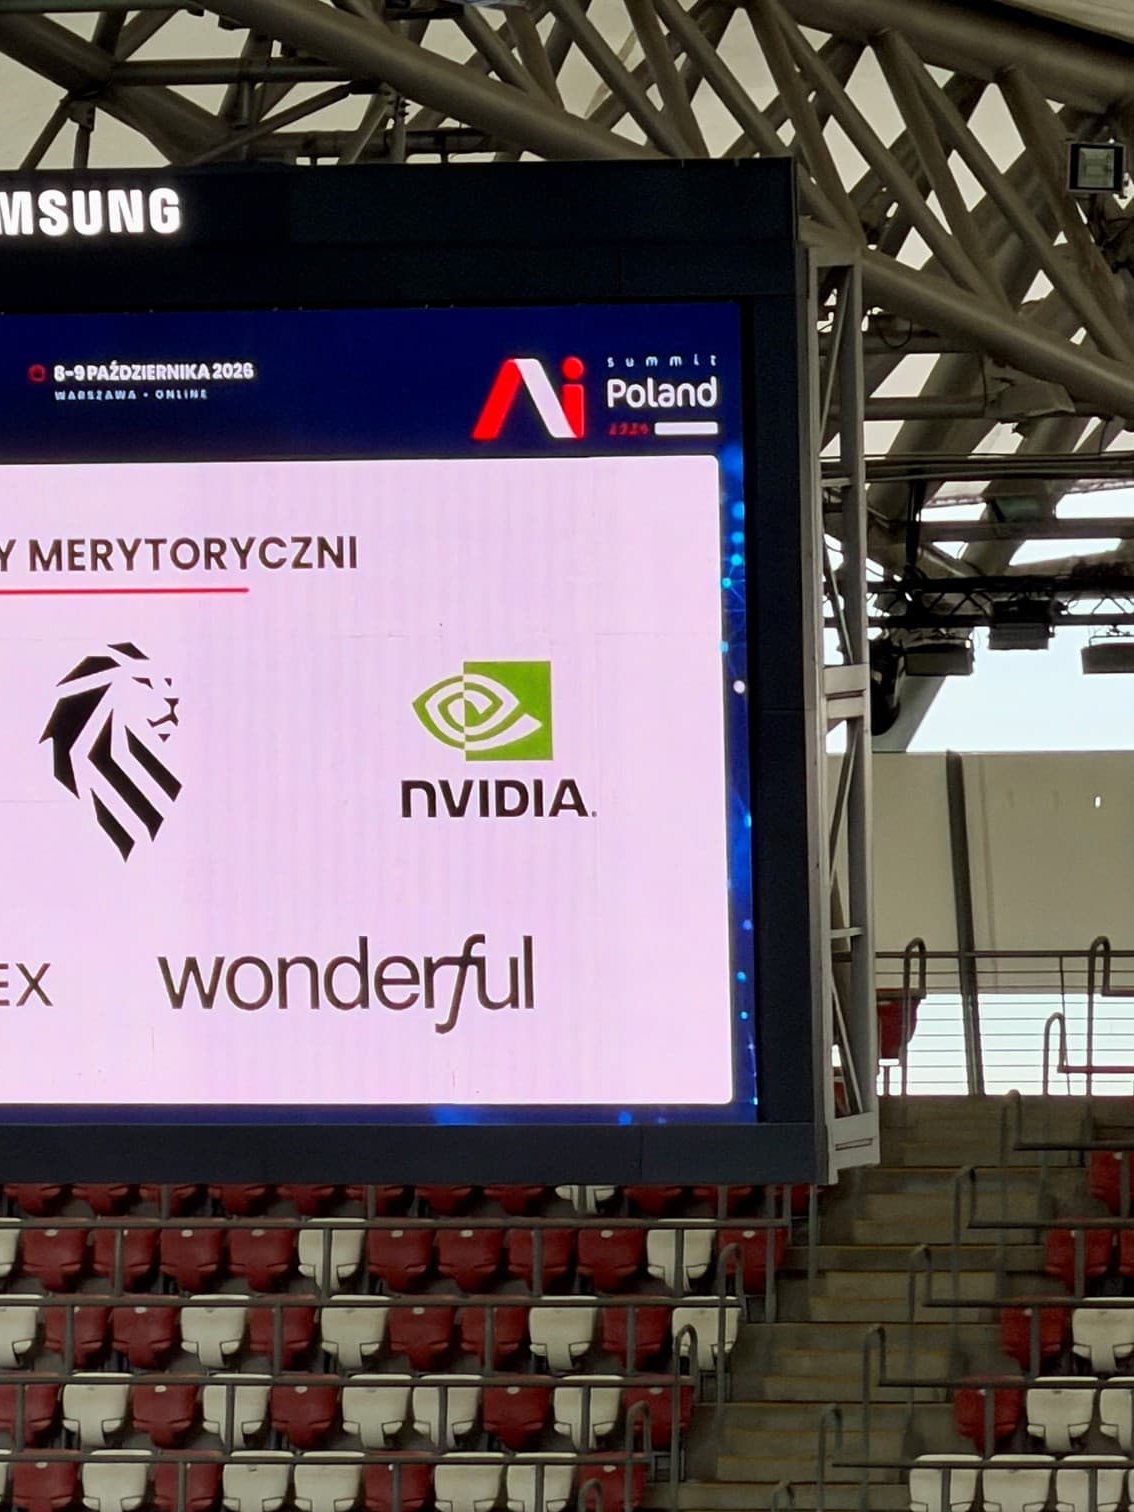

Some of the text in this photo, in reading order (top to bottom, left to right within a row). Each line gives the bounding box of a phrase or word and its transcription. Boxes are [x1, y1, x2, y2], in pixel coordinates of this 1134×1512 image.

[87, 360, 211, 382] PAŹDZIERNIKA
[607, 354, 717, 368] summit
[54, 389, 137, 401] WARSZAWA
[155, 388, 208, 400] ONLINE
[607, 375, 718, 409] Poland
[28, 535, 357, 574] MERYTORYCZNI
[157, 934, 535, 1035] wonderful
